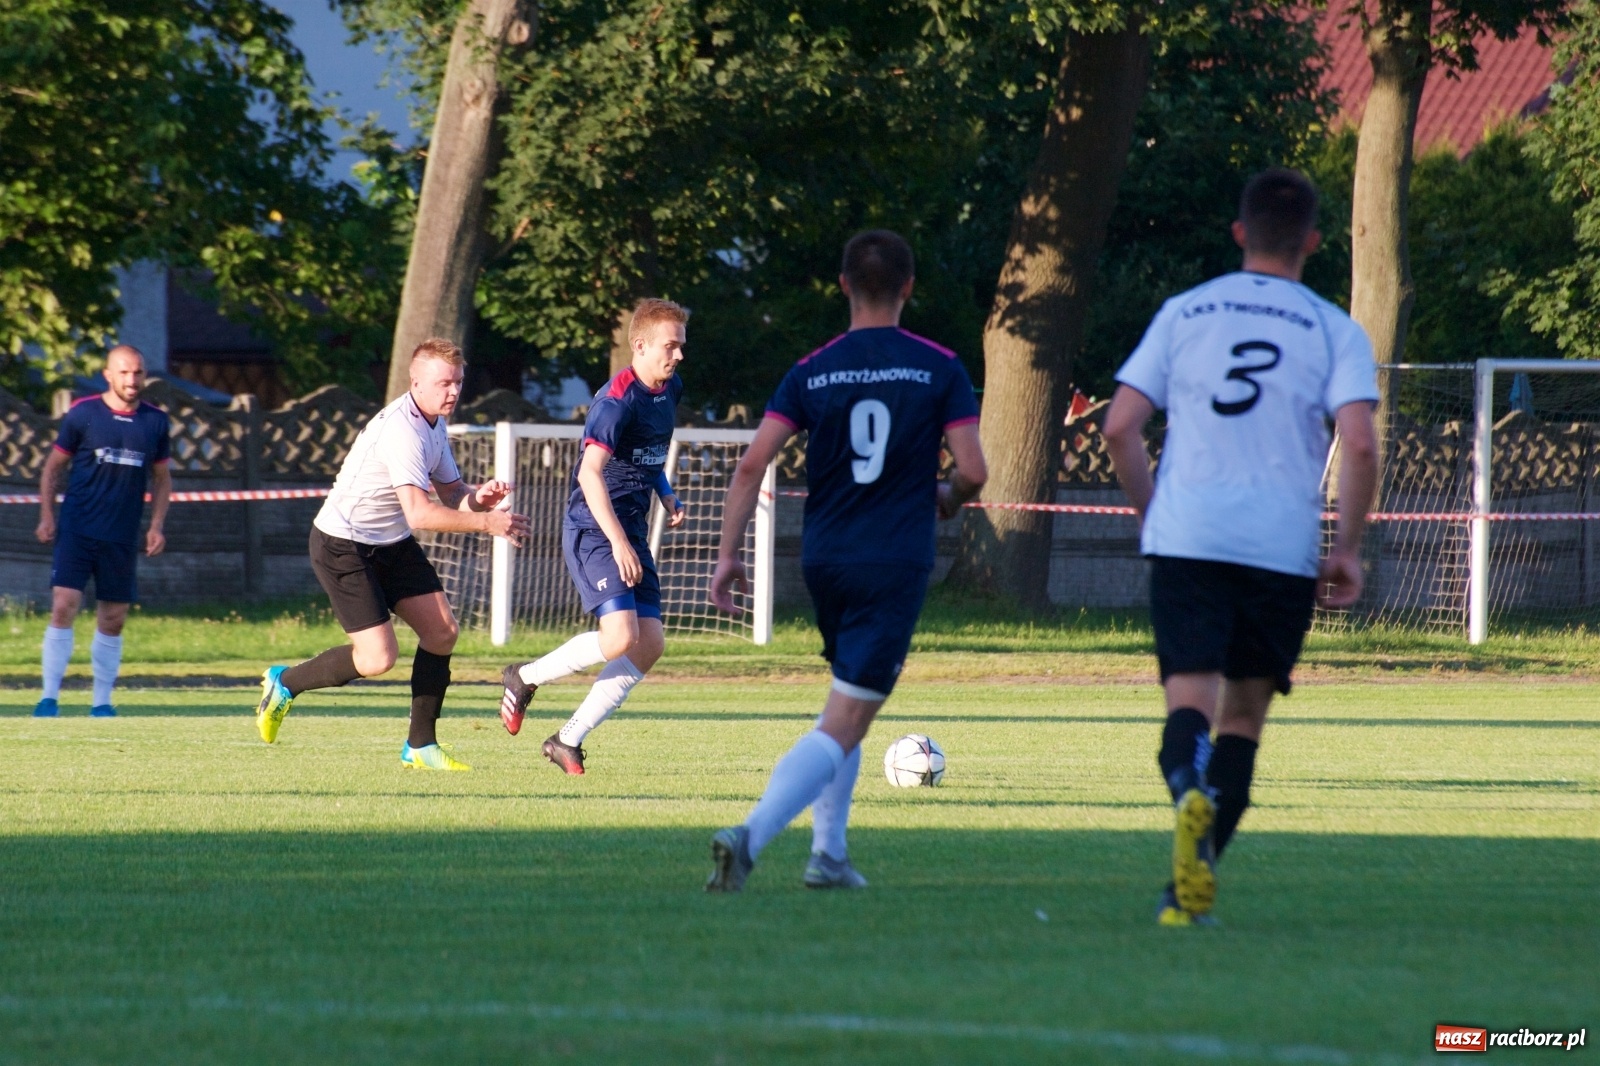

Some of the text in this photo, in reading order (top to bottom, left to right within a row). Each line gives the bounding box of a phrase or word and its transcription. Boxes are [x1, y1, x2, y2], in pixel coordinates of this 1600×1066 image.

[1181, 303, 1217, 320] LKS
[807, 367, 933, 390] LKS KRZYŻANOWICE
[1211, 340, 1283, 417] 3
[850, 398, 892, 485] 9
